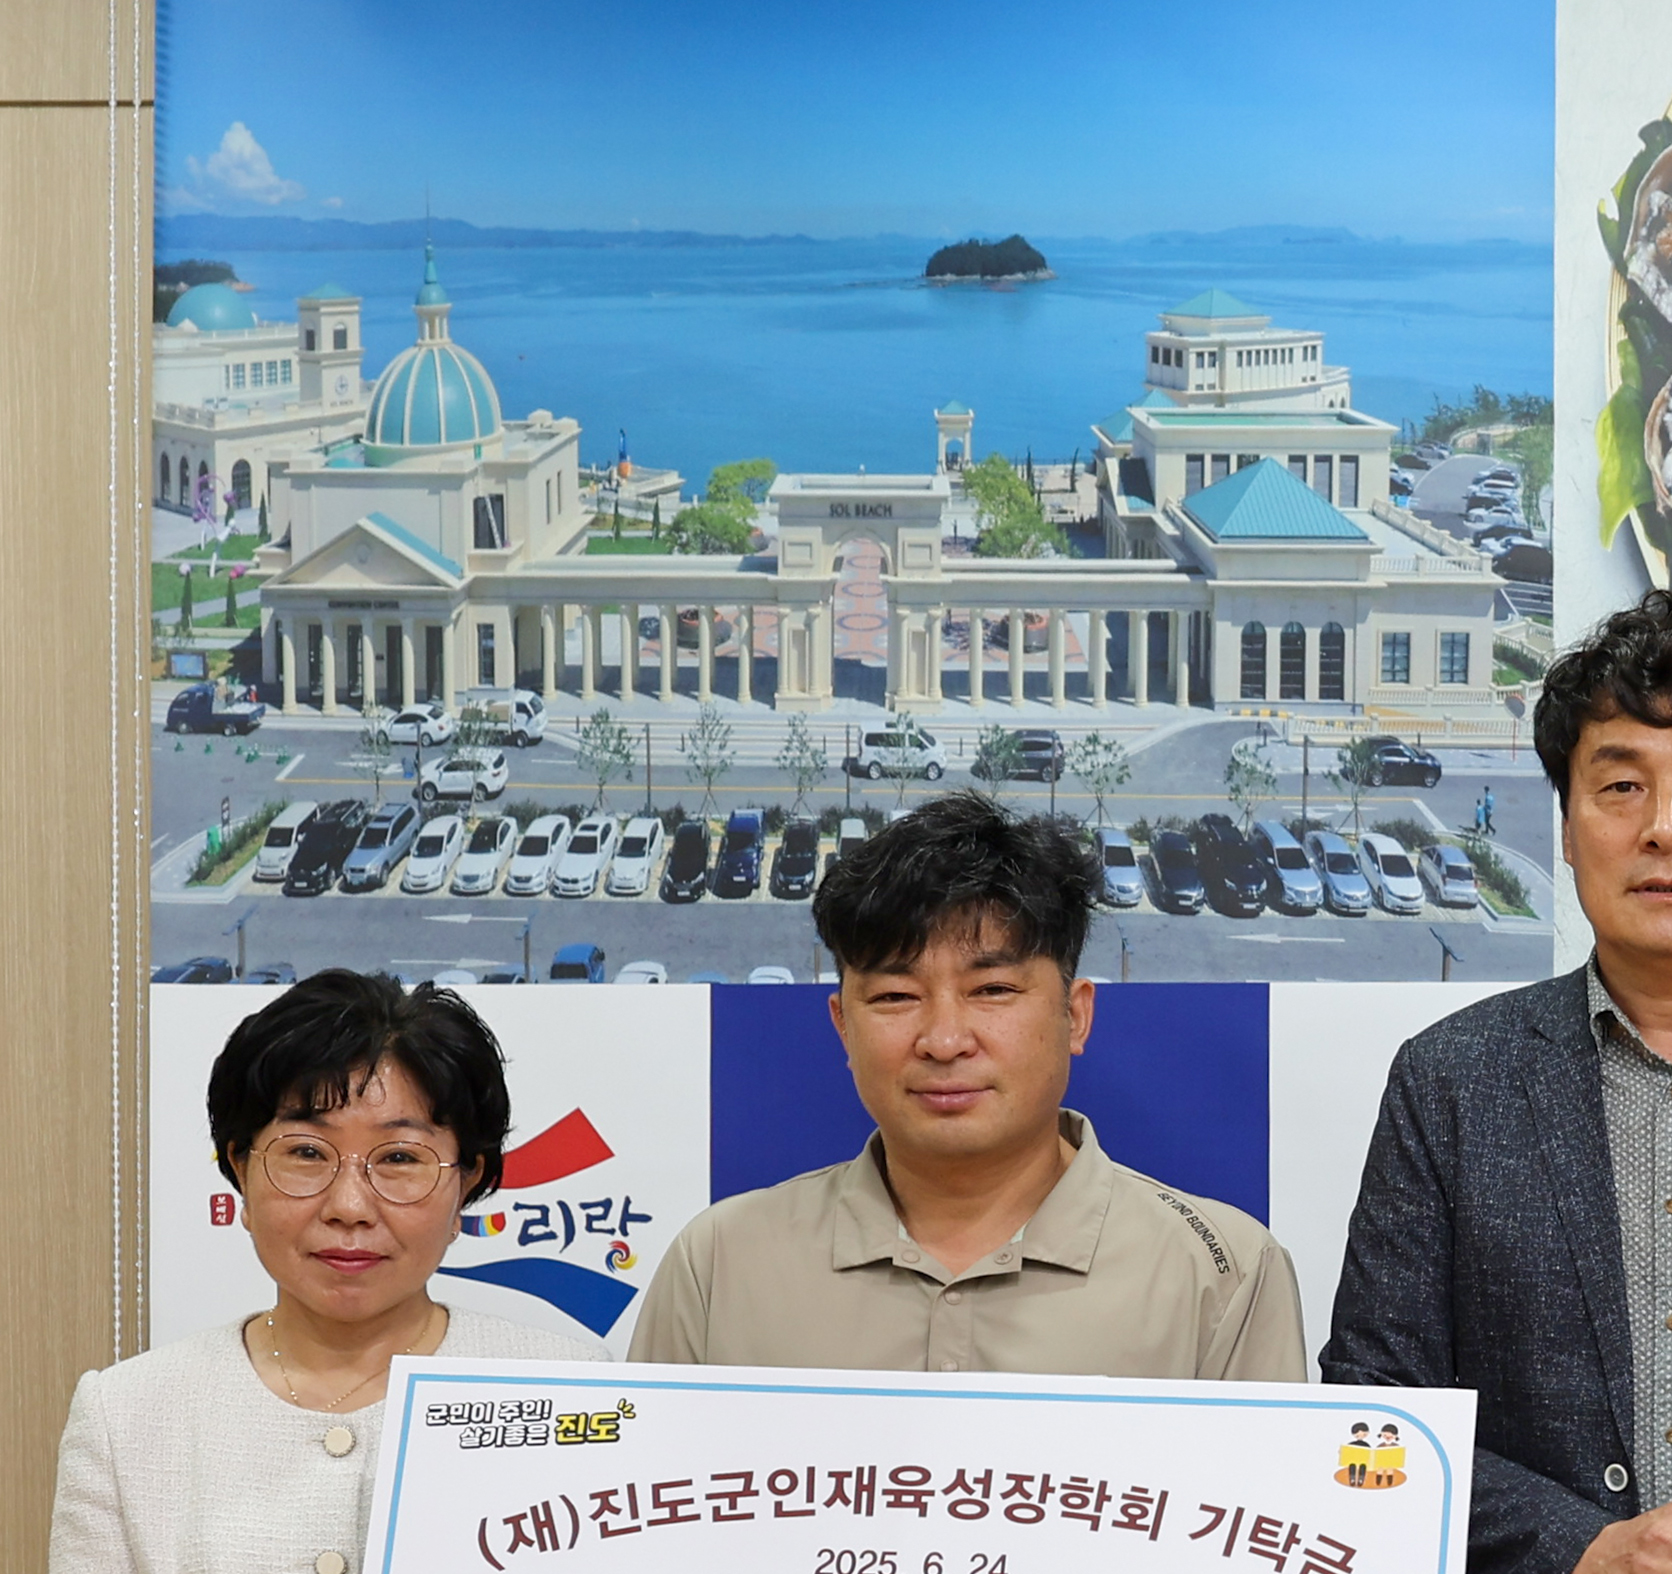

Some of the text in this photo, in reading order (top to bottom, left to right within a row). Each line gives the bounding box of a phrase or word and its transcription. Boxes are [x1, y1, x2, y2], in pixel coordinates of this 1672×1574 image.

[829, 503, 893, 518] SOL BEACH
[1157, 1192, 1230, 1274] BEYOND BOUNDARIES
[426, 1399, 553, 1426] 군민이 주인!
[459, 1411, 621, 1449] 살기좋은 진도
[477, 1465, 1169, 1572] (재)진도군인재육성장학회
